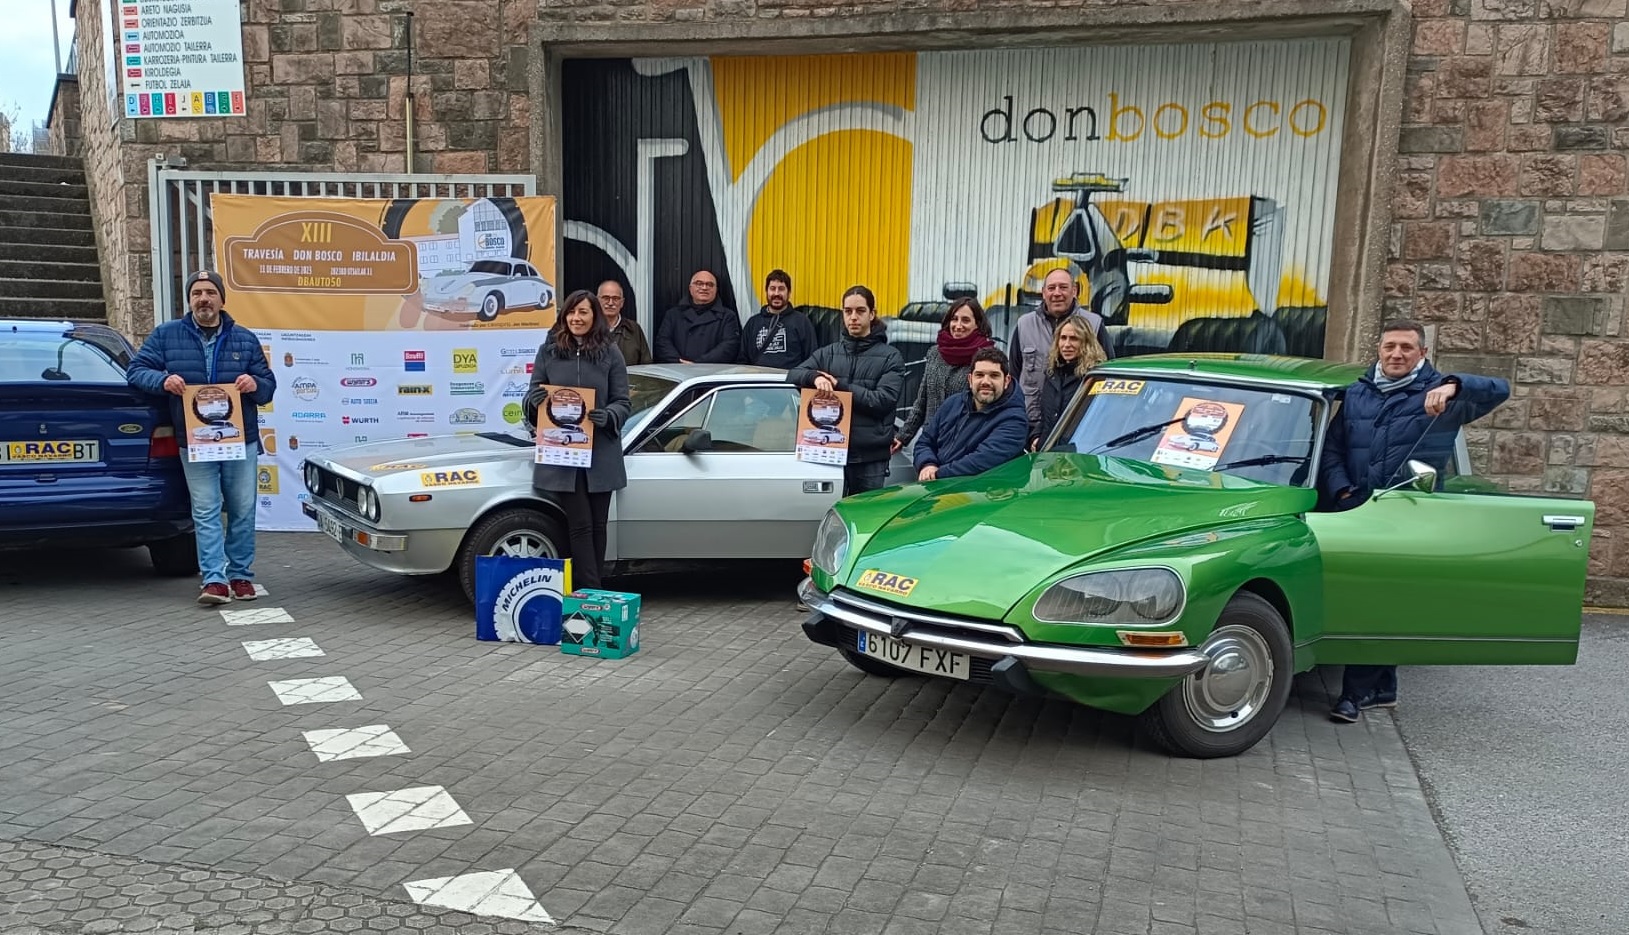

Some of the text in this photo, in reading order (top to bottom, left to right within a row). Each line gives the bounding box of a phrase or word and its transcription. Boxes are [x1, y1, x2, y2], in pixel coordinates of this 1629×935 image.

[141, 4, 192, 15] ARETO NAGUSIA
[142, 16, 213, 28] ORIENTAZIO ZERBITZUA
[142, 30, 184, 40] AUTOMOZIOA
[144, 42, 212, 52] AUTOMOZIO TAILERRA
[144, 53, 238, 66] KARROZERIA-PINTURA TAILERRA
[144, 67, 182, 78] KIROLDEGIA
[146, 80, 192, 89] FUTBOL ZELAIA
[300, 222, 332, 243] XIII
[243, 247, 396, 262] TRAVESÍA DON BOSCO IBILALDIA
[273, 265, 294, 274] FEBRERO
[453, 354, 478, 364] DYA
[1102, 381, 1142, 390] RAC
[26, 442, 71, 454] RAC
[74, 444, 96, 460] BT
[434, 470, 477, 483] RAC
[870, 572, 914, 590] RAC
[502, 574, 552, 612] MICHELIN
[868, 634, 963, 674] 6107 FXF
